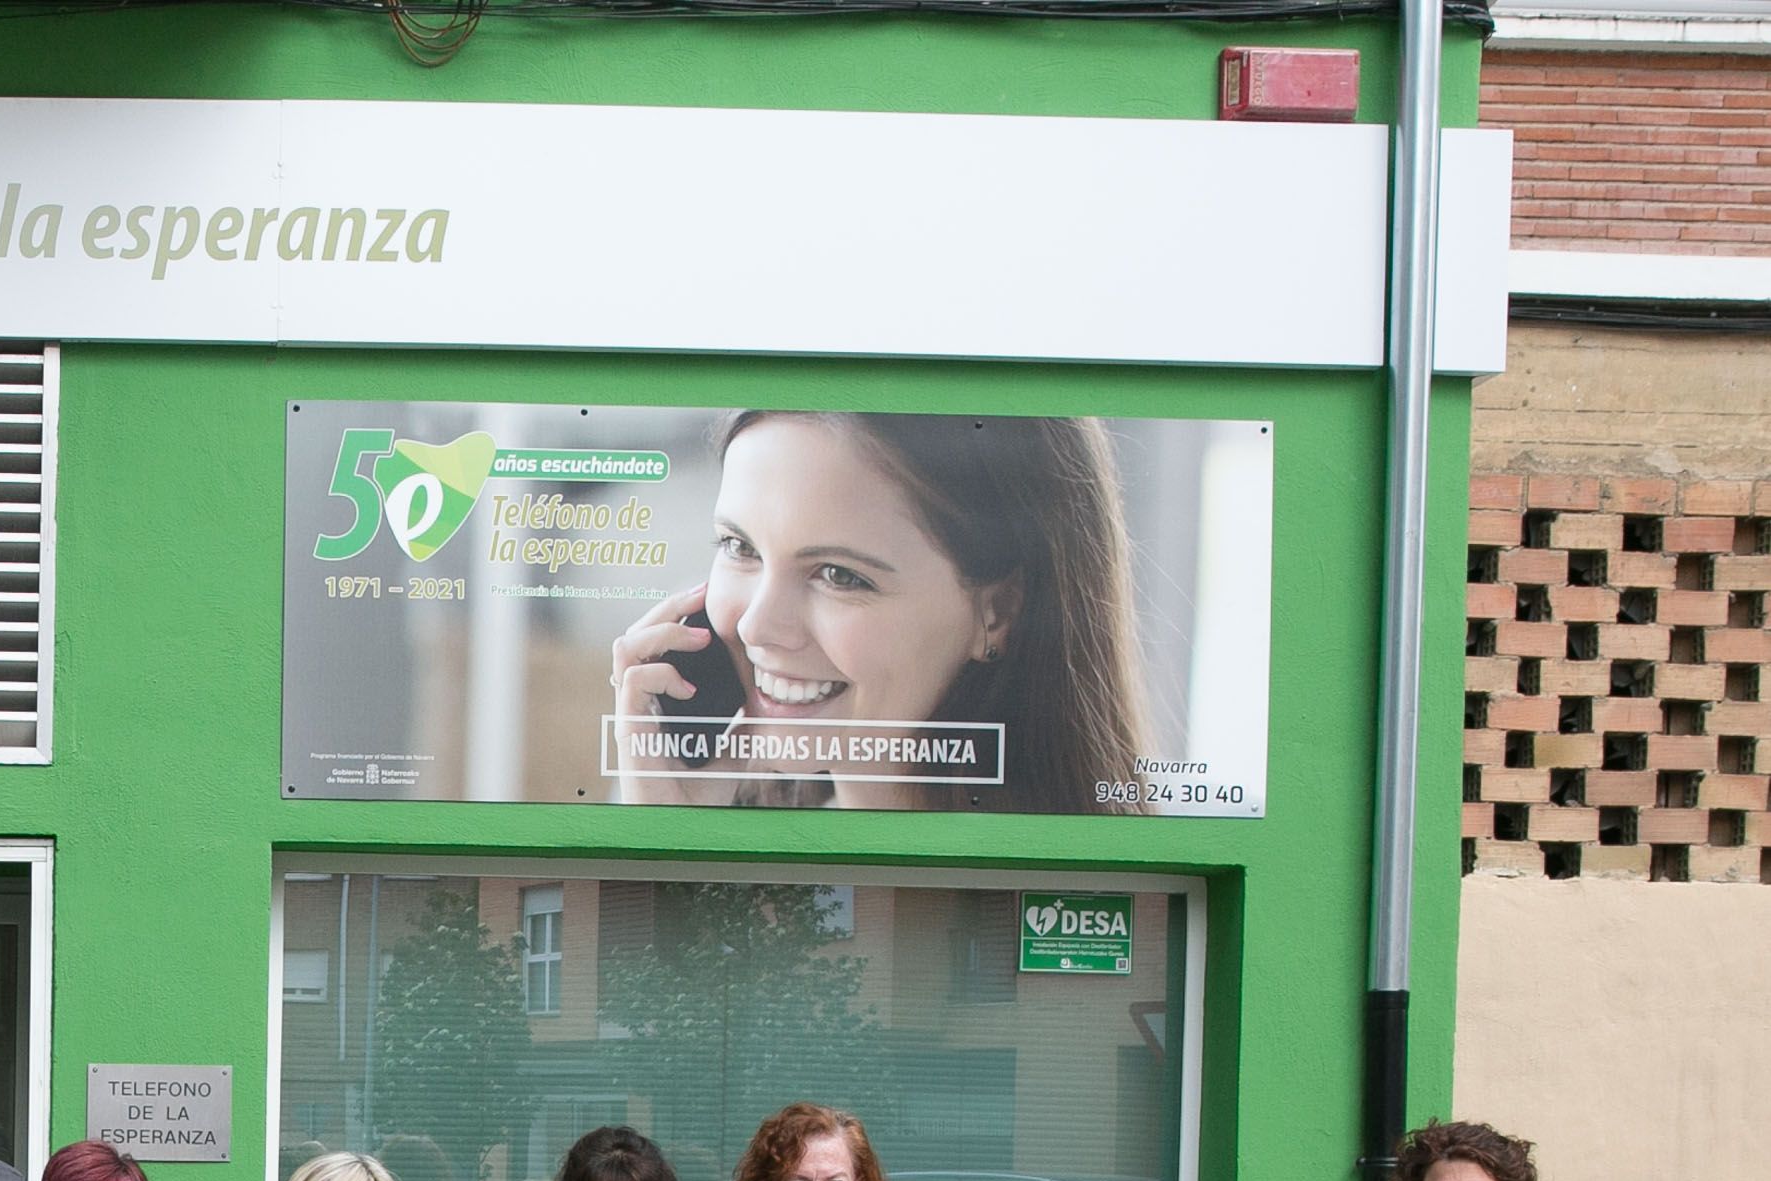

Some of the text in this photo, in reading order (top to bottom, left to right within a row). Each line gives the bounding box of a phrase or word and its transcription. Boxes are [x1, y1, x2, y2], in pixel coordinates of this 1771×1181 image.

[81, 204, 450, 280] esperanza
[494, 454, 664, 475] años escuchándote
[493, 494, 652, 531] Teléfono de
[489, 530, 668, 573] la esperanza
[325, 576, 381, 598] 1971
[408, 577, 465, 600] 2021
[630, 732, 976, 764] NUNCA PIERDAS LA ESPERANZA
[1135, 758, 1207, 774] Navarra
[1097, 783, 1243, 803] 948 24 30 40
[1061, 910, 1127, 935] DESA
[108, 1081, 211, 1097] TELEFONO
[128, 1105, 189, 1121] DE LA
[101, 1128, 216, 1145] ESPERANZA
